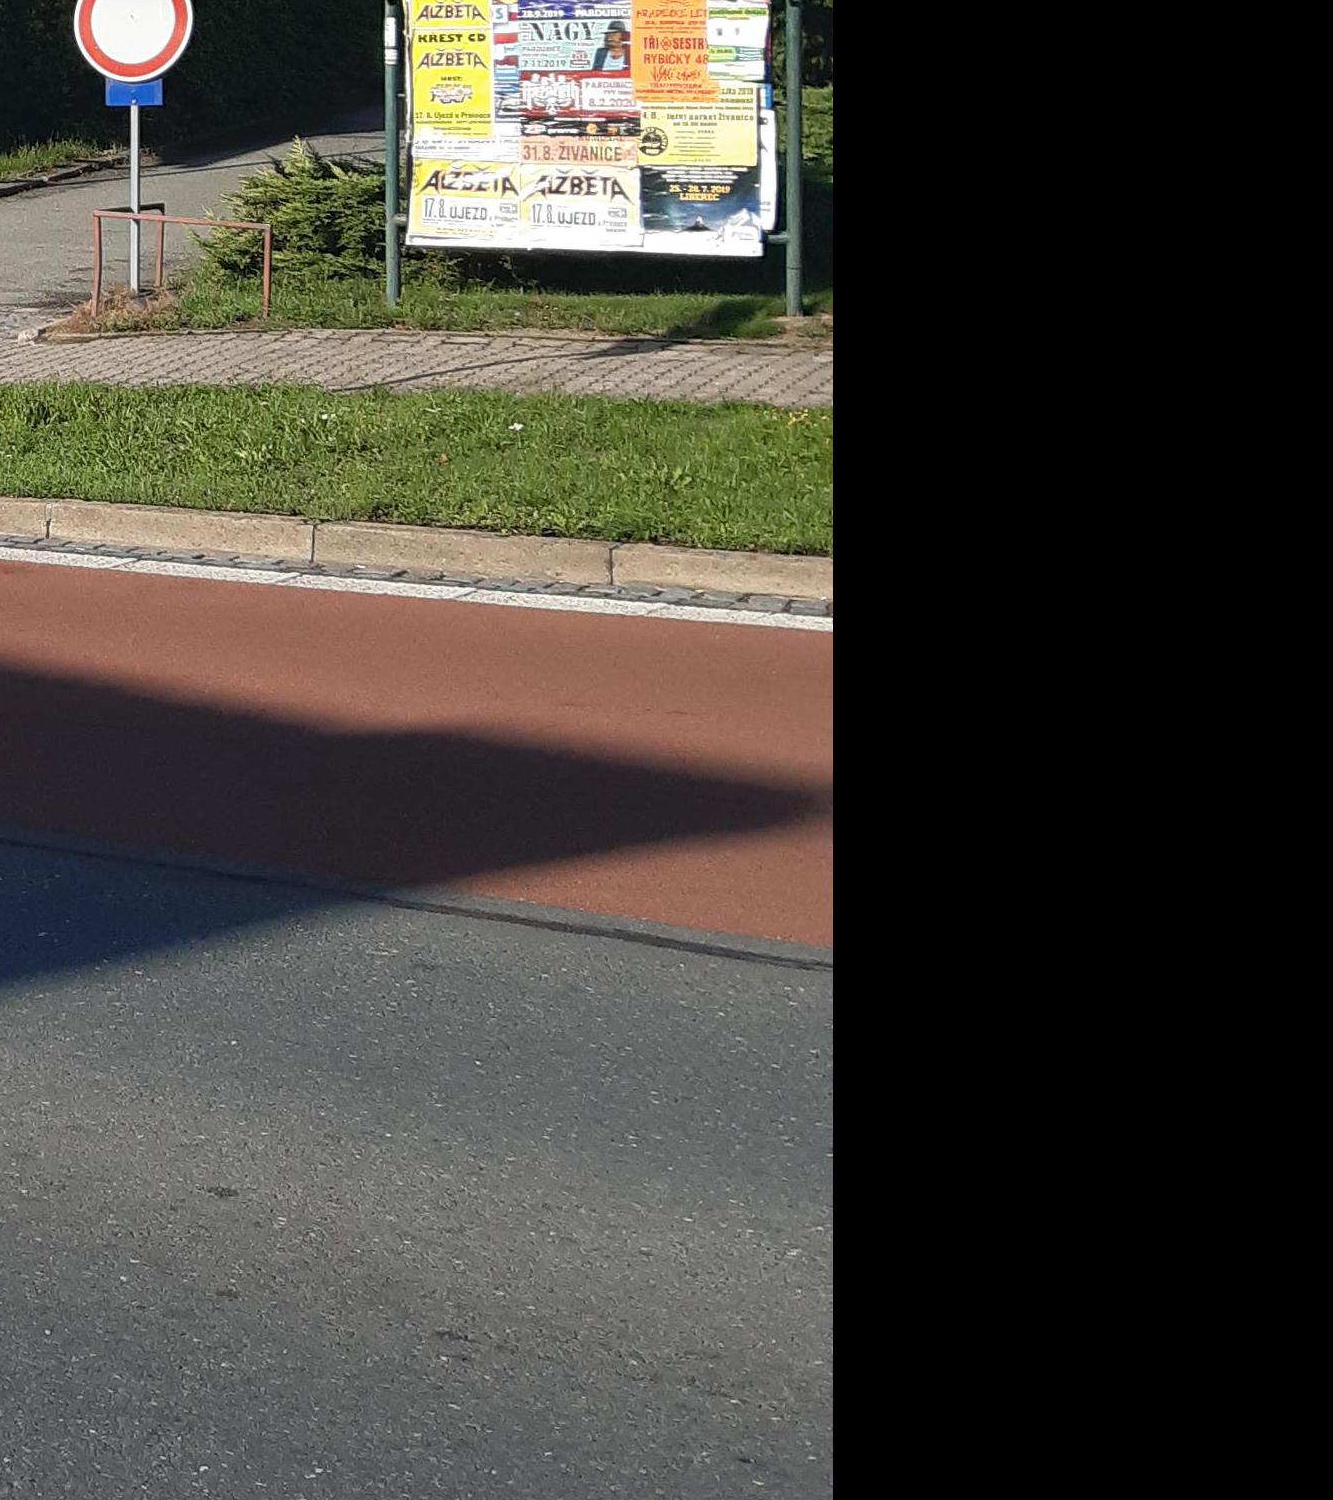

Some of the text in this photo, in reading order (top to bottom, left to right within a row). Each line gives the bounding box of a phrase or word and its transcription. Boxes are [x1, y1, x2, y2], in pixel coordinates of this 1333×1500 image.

[416, 0, 488, 22] ALŽBĚTA
[468, 33, 486, 42] CD
[529, 21, 597, 42] NAGY
[643, 36, 659, 50] TŘI
[416, 48, 488, 70] ALŽBĚTA
[643, 51, 691, 64] RYBIČKY
[523, 145, 554, 160] 31.8.
[558, 142, 622, 161] ŽIVANICE
